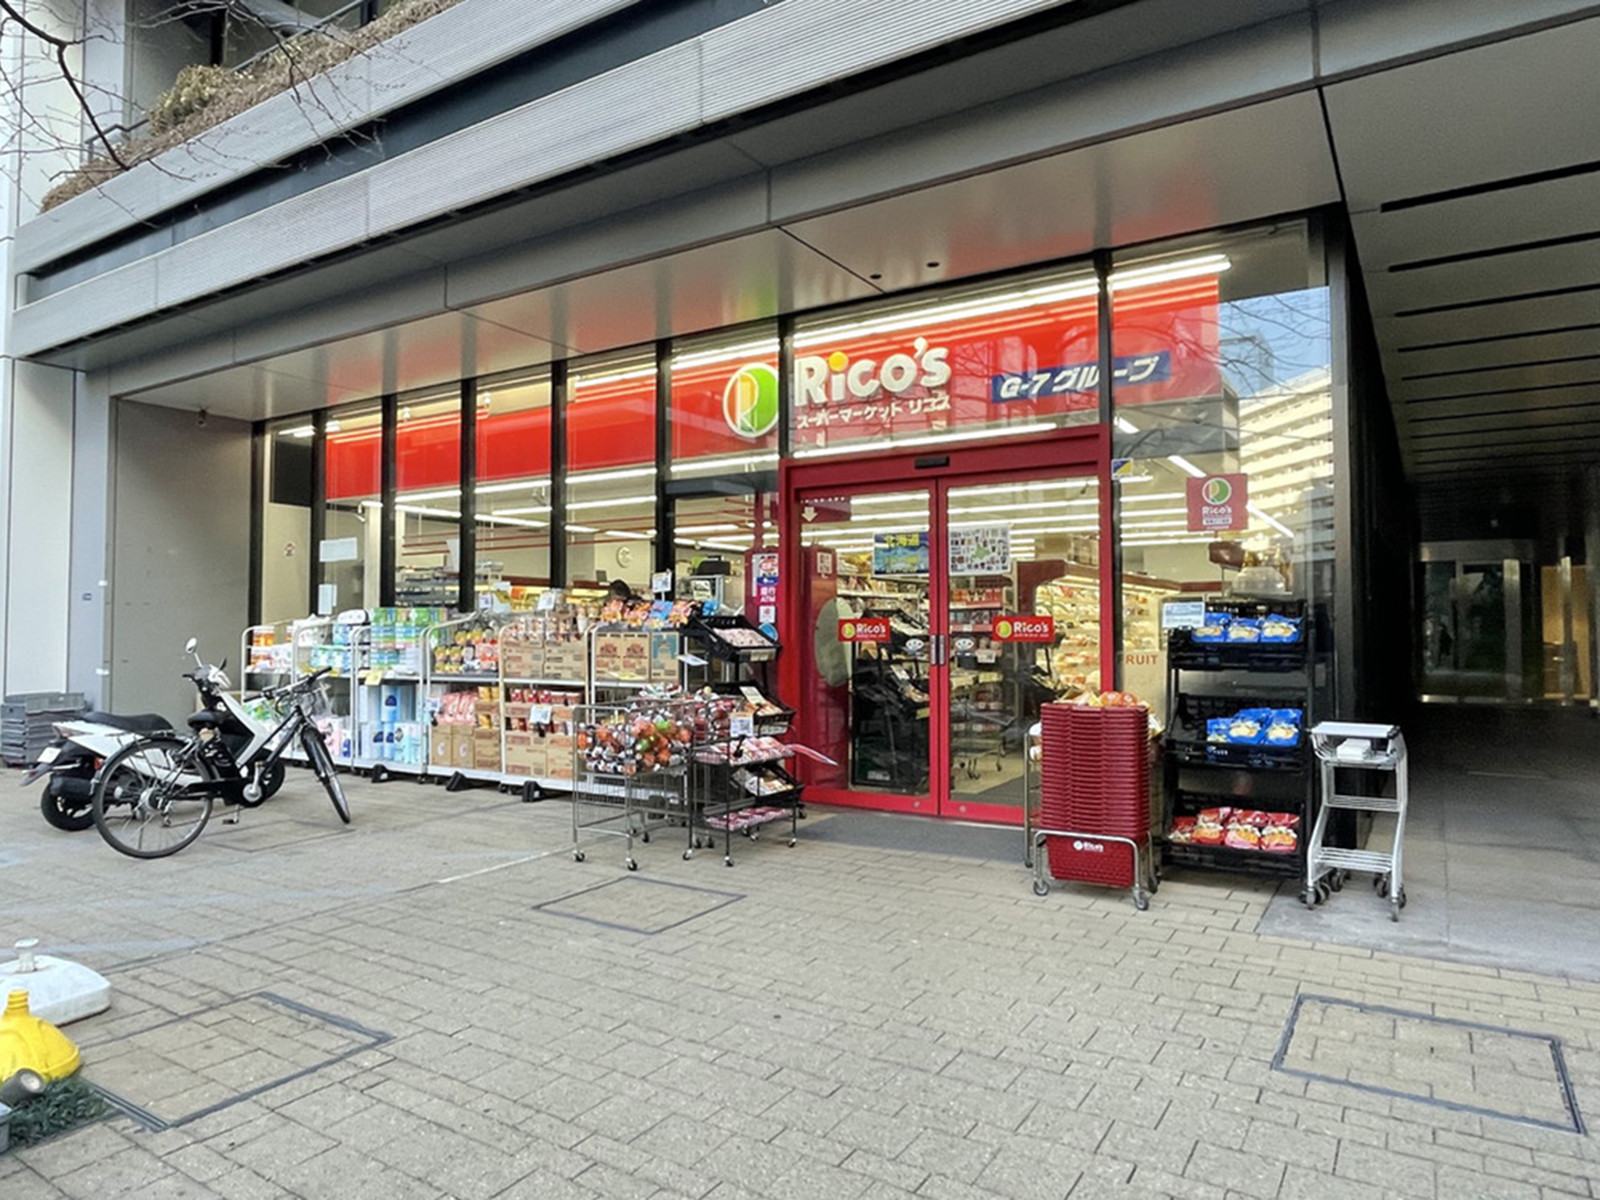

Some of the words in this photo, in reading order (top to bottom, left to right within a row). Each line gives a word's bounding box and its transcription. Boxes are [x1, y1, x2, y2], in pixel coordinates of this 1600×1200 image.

[794, 337, 952, 407] Rico's
[797, 402, 903, 429] スーパーマーケット
[856, 623, 886, 634] Rico's
[1013, 621, 1049, 633] Rico's
